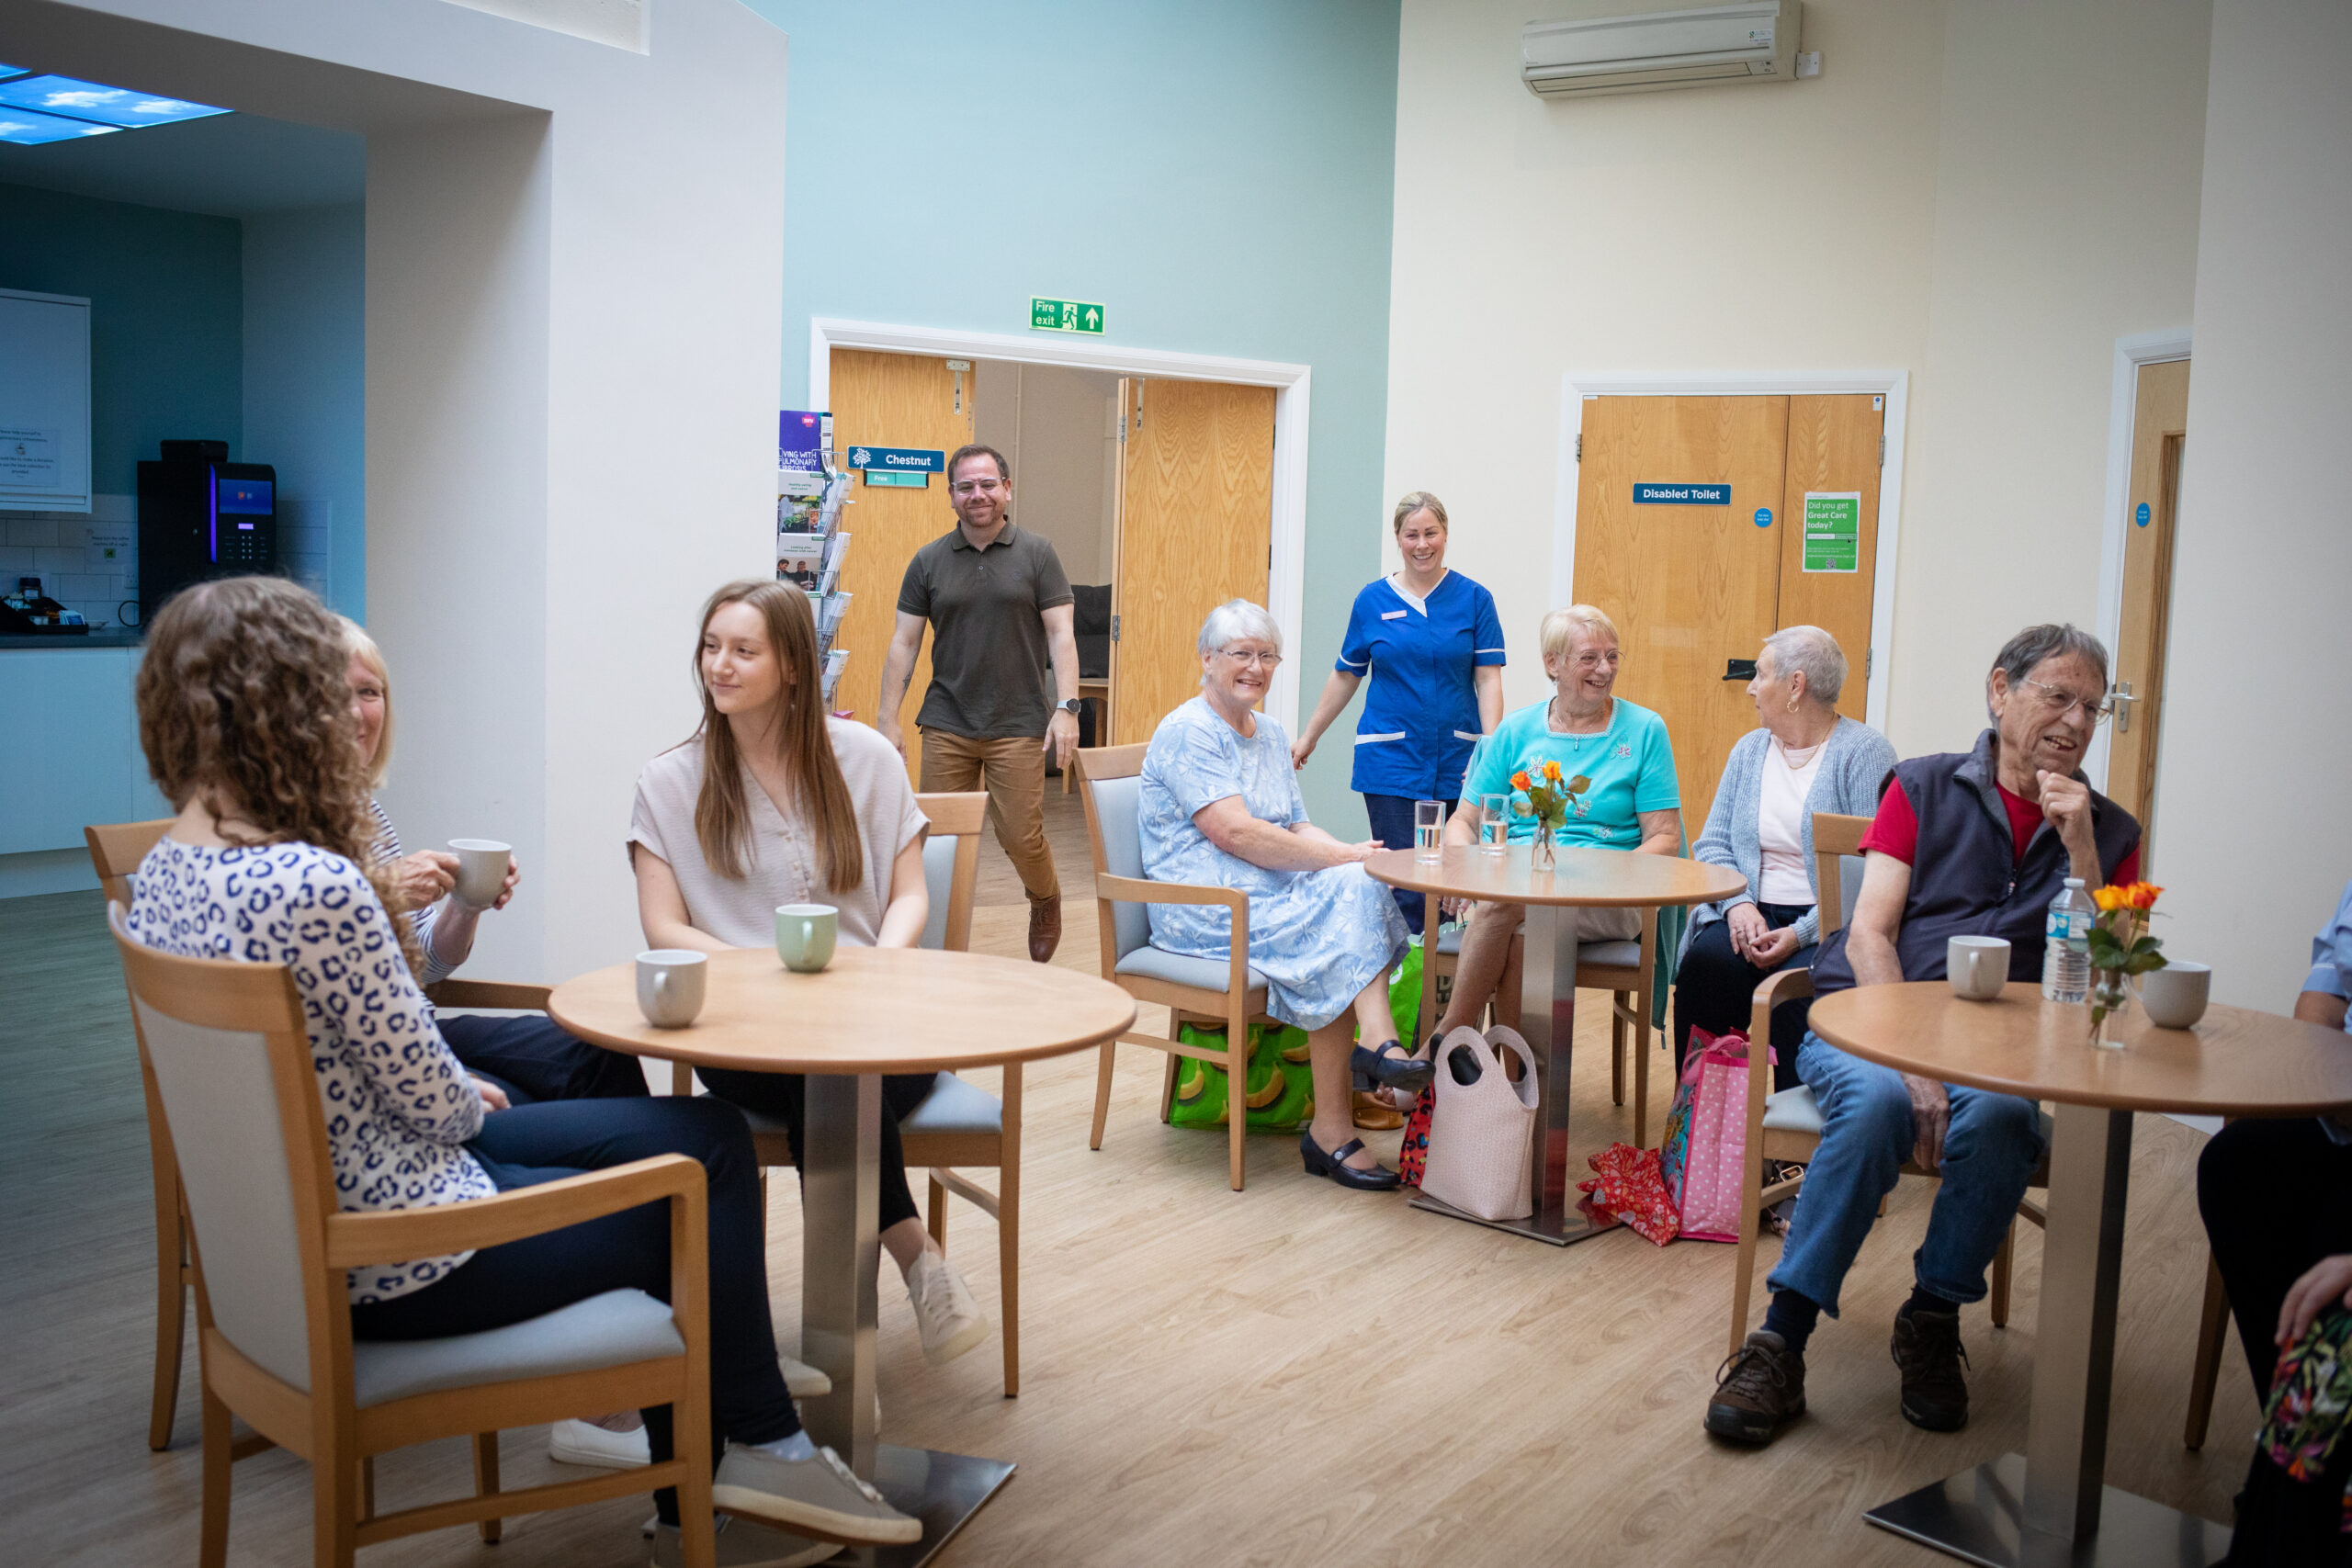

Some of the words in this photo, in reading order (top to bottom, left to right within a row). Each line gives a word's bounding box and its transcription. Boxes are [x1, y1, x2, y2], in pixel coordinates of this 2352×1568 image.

[1035, 300, 1056, 312] Fire
[1035, 315, 1056, 326] exit
[886, 454, 932, 466] Chestnut
[1643, 489, 1689, 499] Disabled
[1690, 490, 1721, 500] Toilet
[1822, 502, 1836, 511] you
[1837, 502, 1849, 511] get
[1807, 522, 1833, 530] today?
